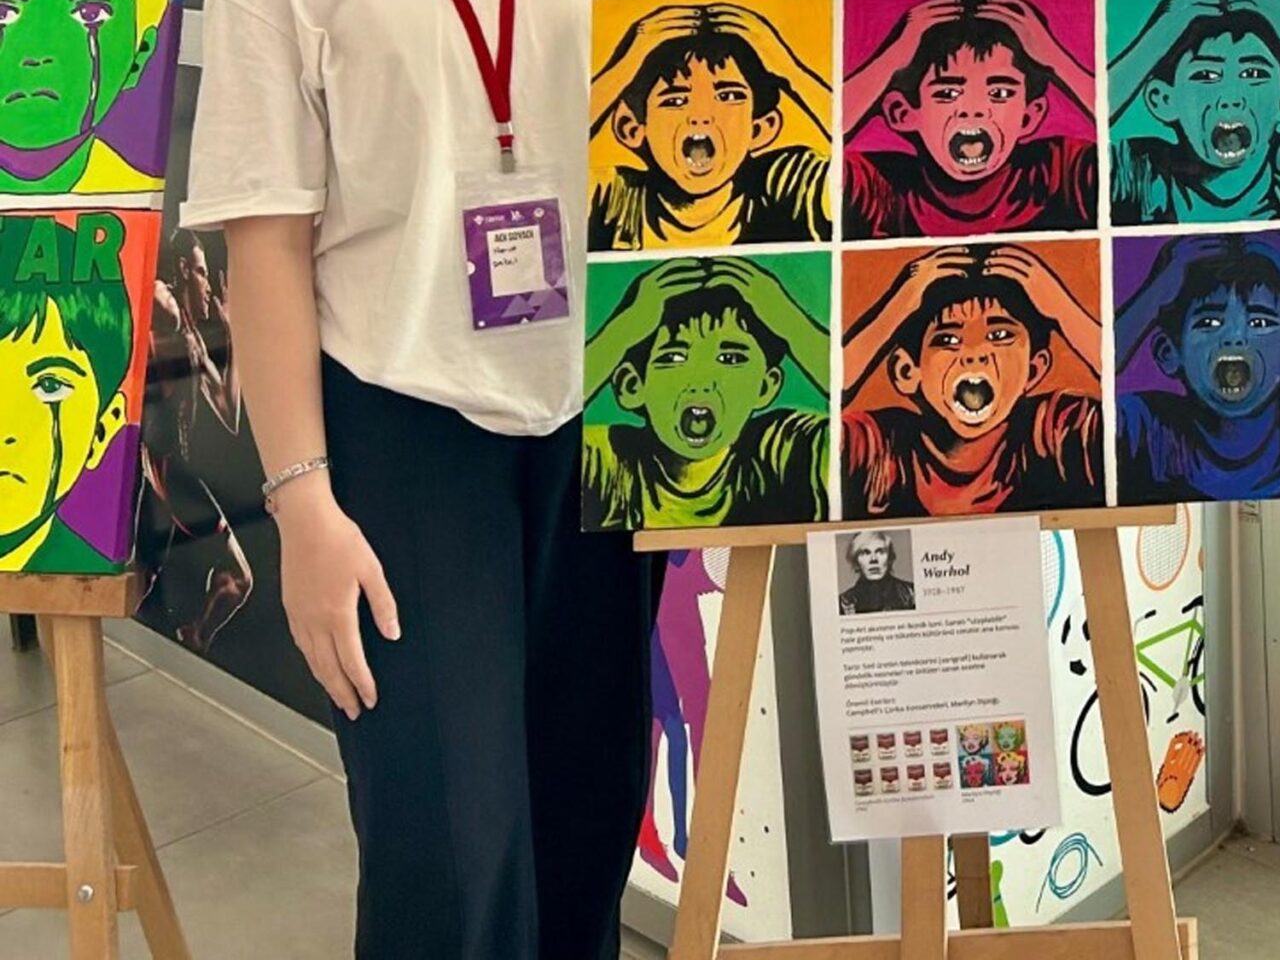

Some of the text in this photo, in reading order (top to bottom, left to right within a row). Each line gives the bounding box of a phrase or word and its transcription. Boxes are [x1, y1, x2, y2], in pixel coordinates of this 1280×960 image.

[0, 212, 126, 285] AR
[920, 549, 955, 564] Andy
[923, 564, 970, 578] Warhol
